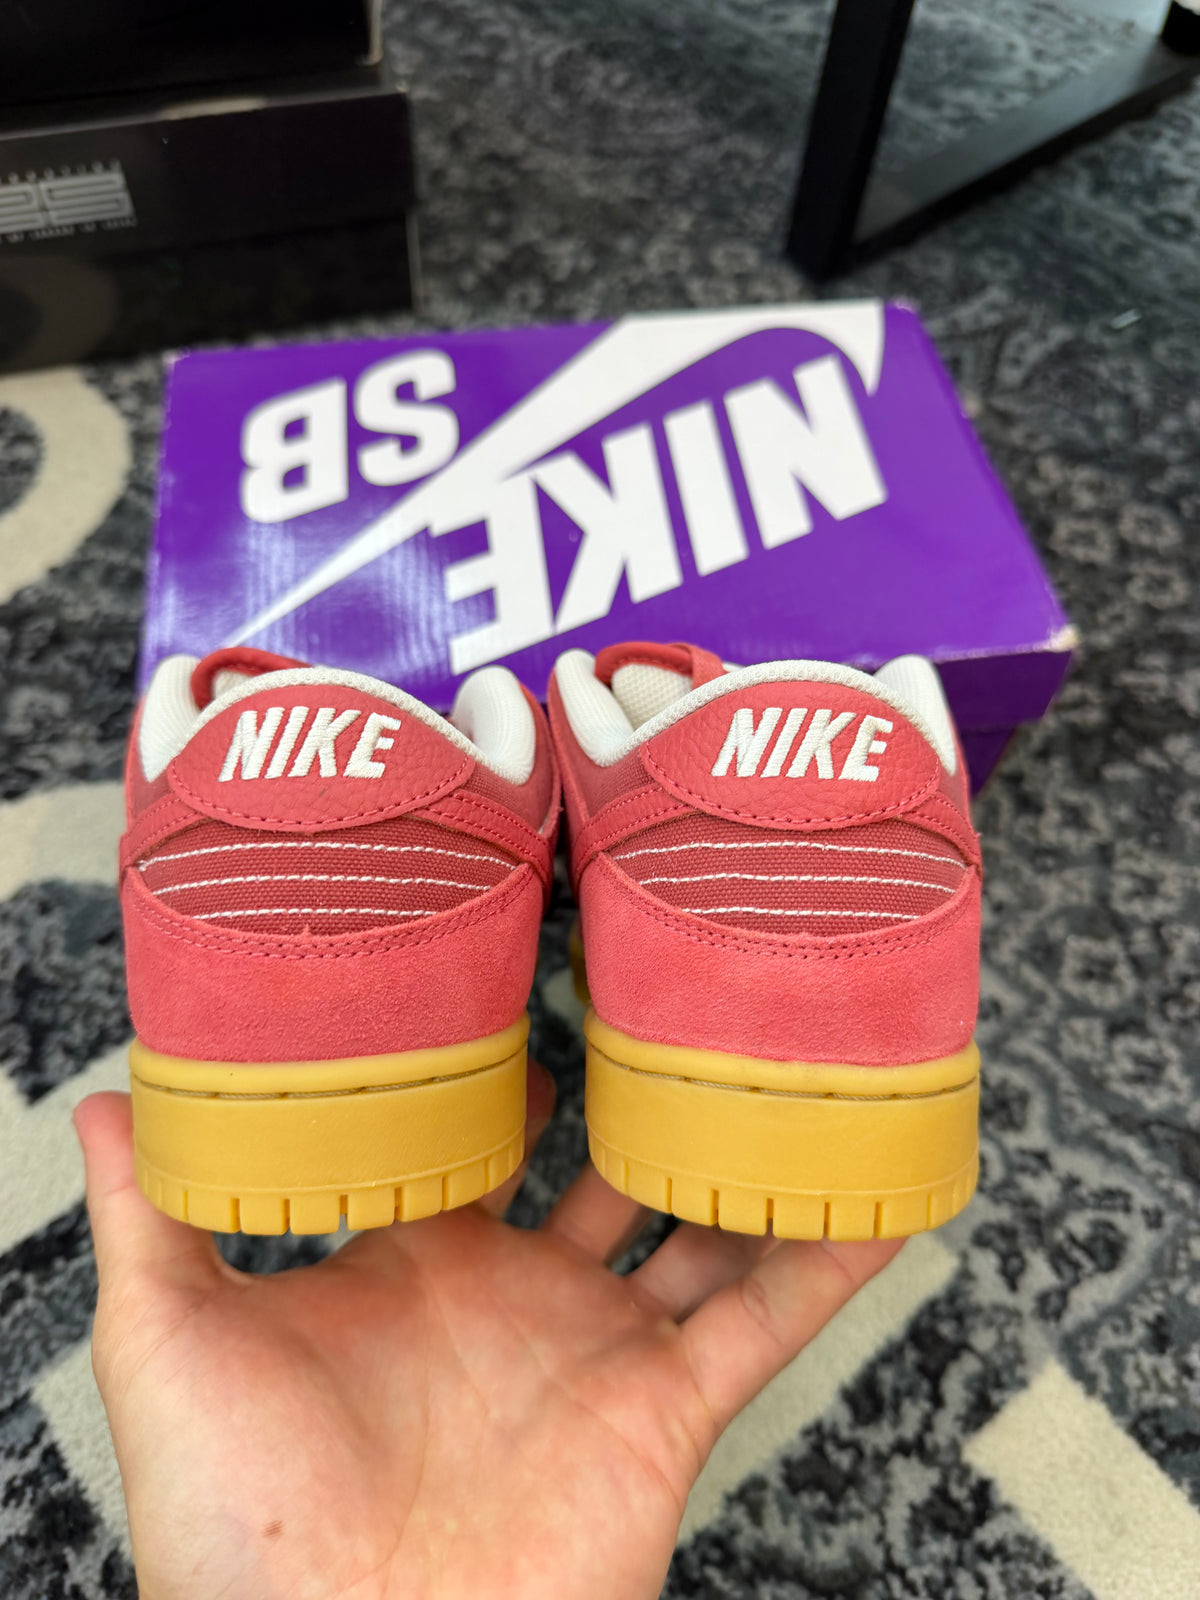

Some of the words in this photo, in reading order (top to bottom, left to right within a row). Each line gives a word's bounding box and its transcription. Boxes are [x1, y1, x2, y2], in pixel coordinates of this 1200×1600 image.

[242, 349, 460, 523] SB
[430, 355, 886, 675] NIKE
[218, 705, 402, 782] NIKE
[711, 707, 893, 783] NIKE
